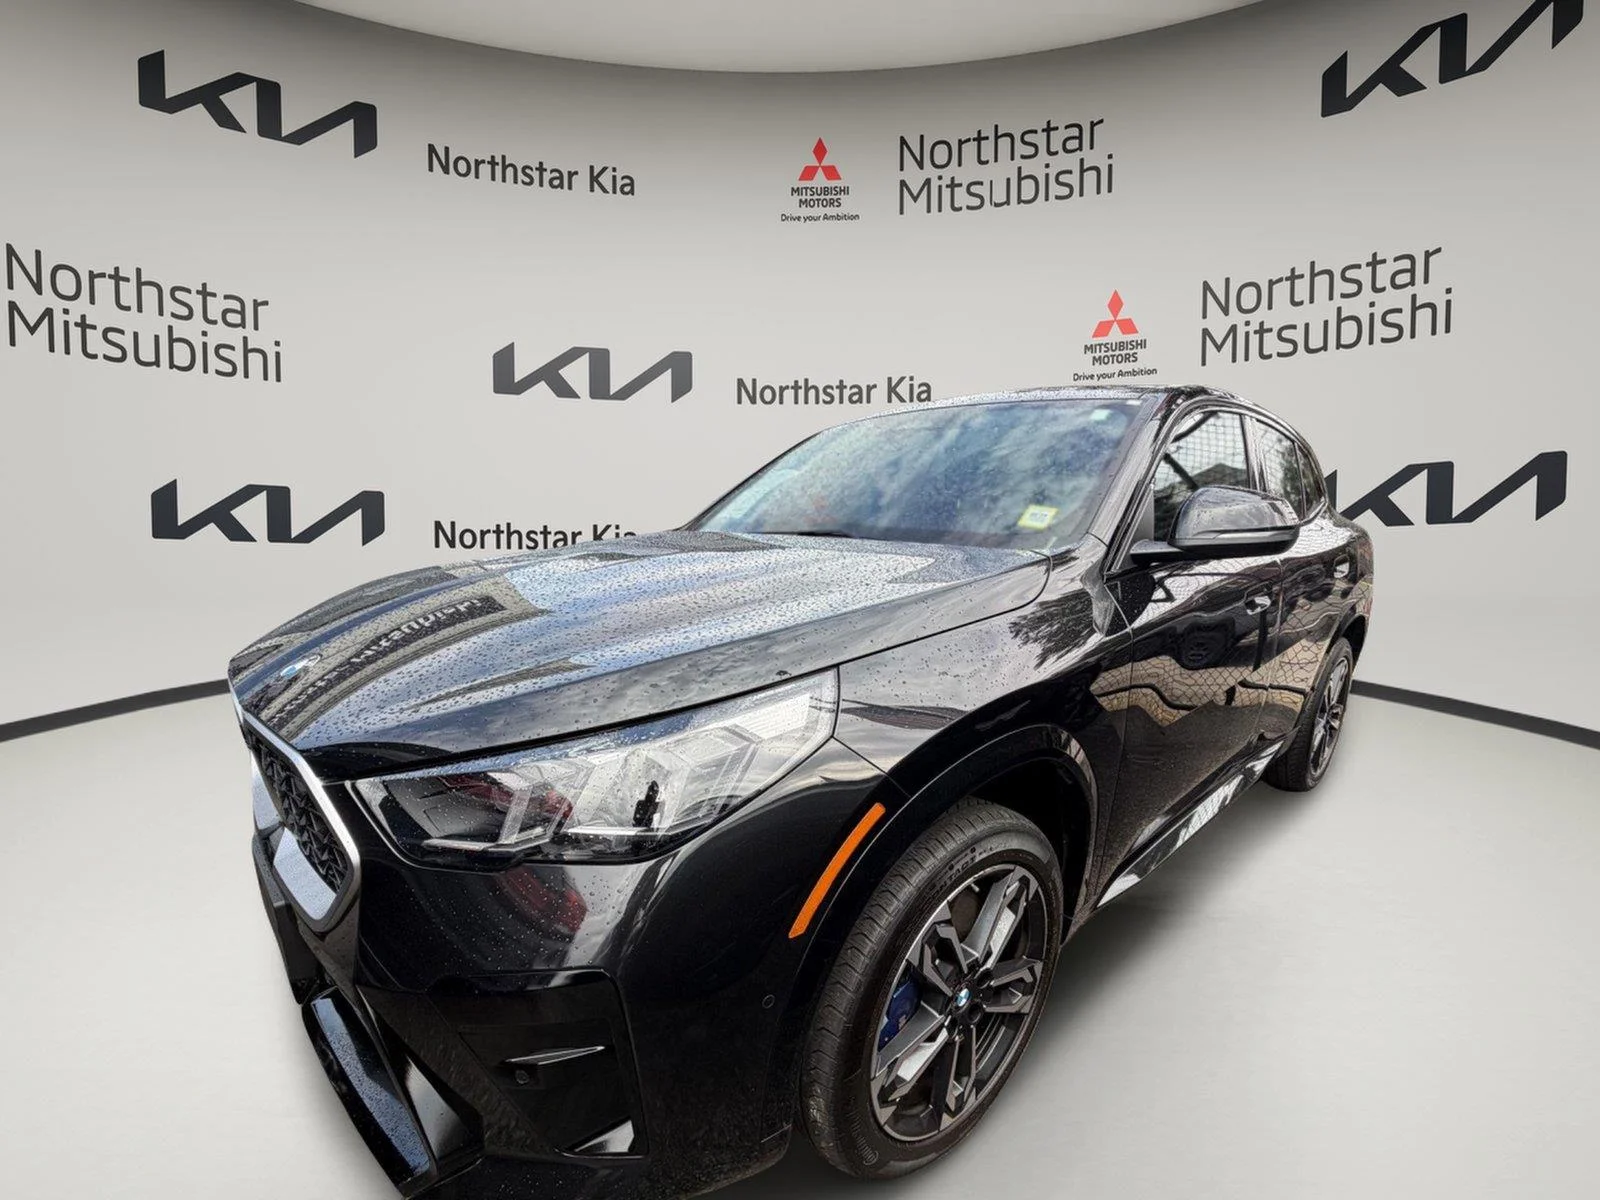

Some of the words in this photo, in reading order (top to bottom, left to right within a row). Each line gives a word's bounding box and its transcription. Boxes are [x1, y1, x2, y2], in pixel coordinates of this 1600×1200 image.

[138, 49, 377, 158] KIA
[428, 143, 580, 191] Northstar
[588, 164, 635, 197] Kia
[900, 118, 1105, 172] Northstar
[790, 185, 850, 197] MITSUBISHI
[798, 198, 842, 208] MOTORS
[900, 153, 1114, 215] Mitsubishi
[780, 213, 802, 222] Drive
[803, 214, 822, 223] your
[822, 212, 860, 222] Ambition
[6, 243, 270, 332] Northstar
[1202, 247, 1442, 320] Northstar
[8, 300, 282, 383] Mitsubishi
[1083, 338, 1147, 355] MITSUBISHI
[1201, 287, 1453, 367] Mitsubishi
[492, 342, 693, 403] KIA
[1072, 372, 1095, 382] Drive
[1096, 371, 1116, 382] your
[1117, 367, 1158, 378] Ambition
[1091, 352, 1139, 366] MOTORS
[737, 378, 878, 406] Northstar
[886, 376, 932, 404] Kia
[151, 479, 385, 547] KIA
[434, 520, 583, 550] Northstar
